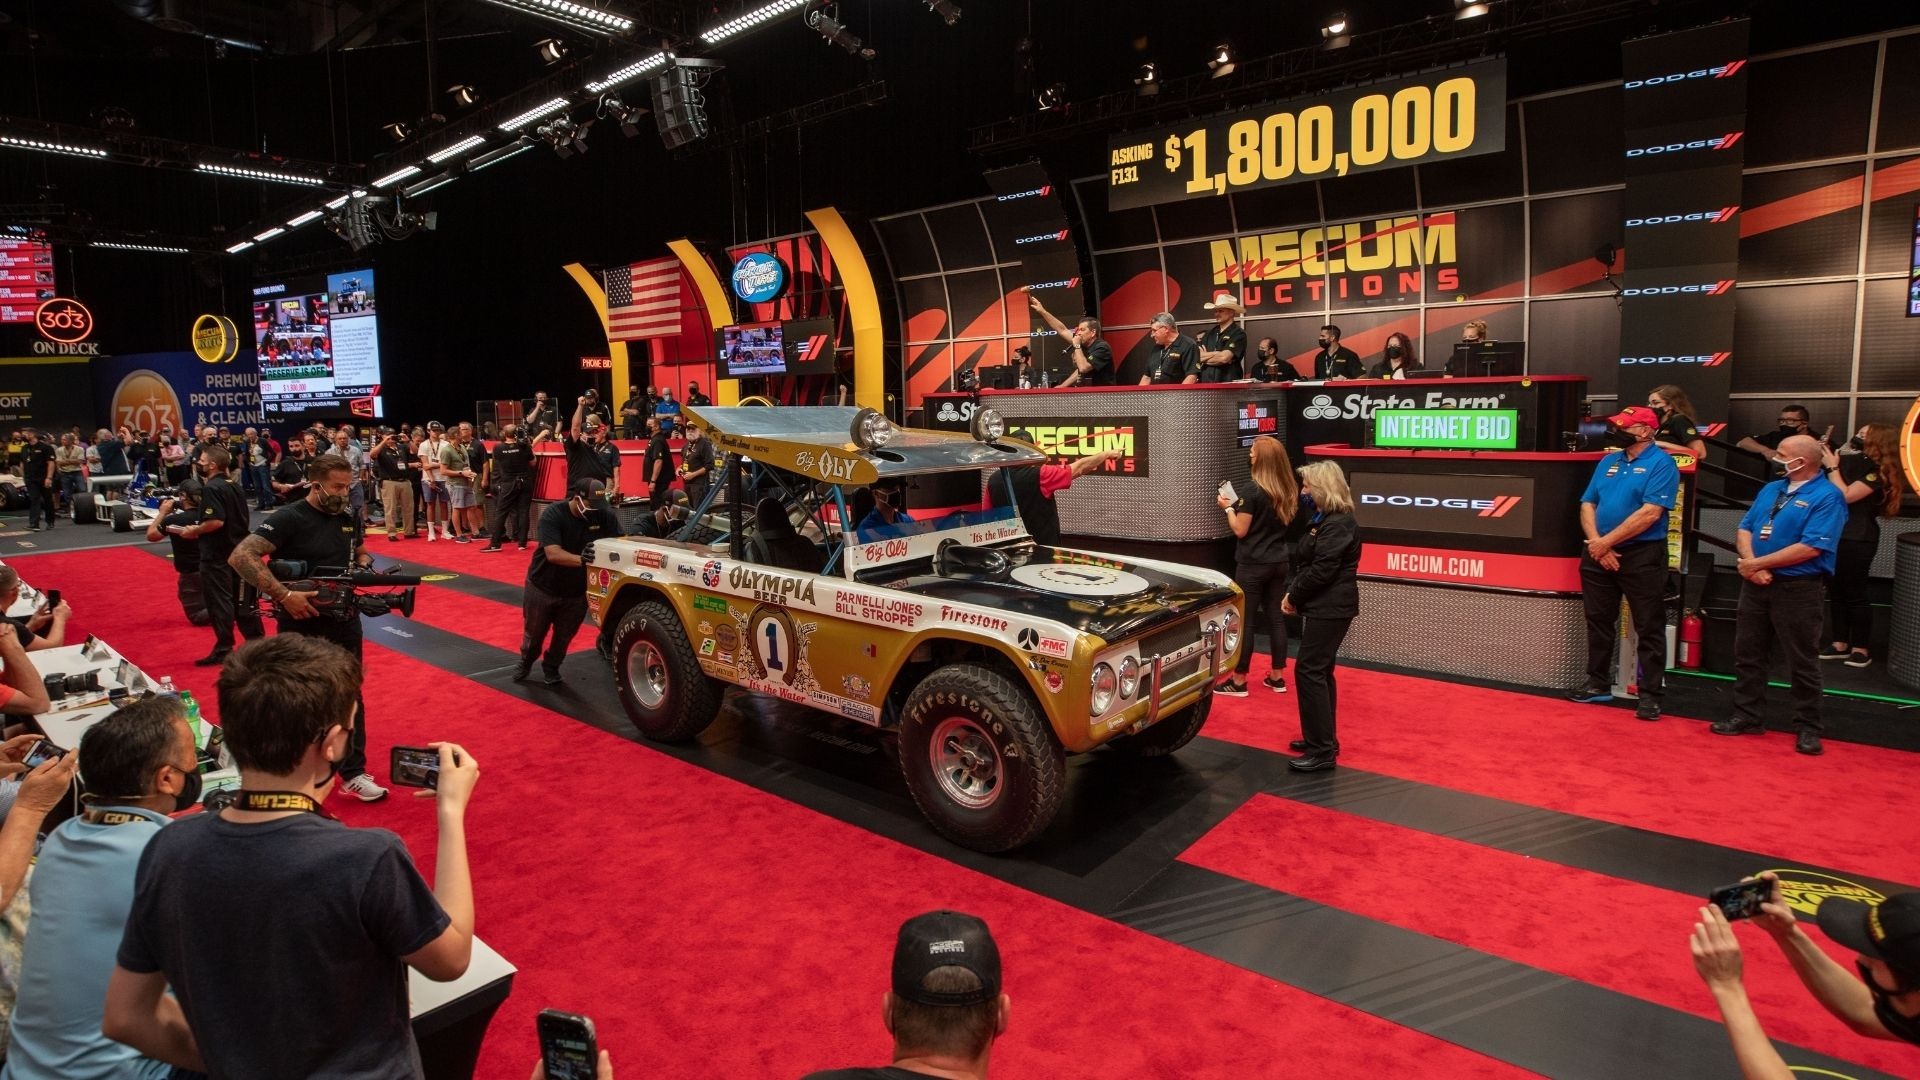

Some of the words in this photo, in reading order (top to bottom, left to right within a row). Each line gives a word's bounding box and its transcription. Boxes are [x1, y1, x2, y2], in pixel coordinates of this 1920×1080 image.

[1625, 66, 1728, 88] DODGE
[1112, 142, 1153, 166] ASKING
[1165, 77, 1475, 195] $1,800,000
[1627, 138, 1725, 157] DODGE
[1112, 165, 1138, 185] F131
[998, 188, 1043, 201] DODGE
[1626, 211, 1722, 227] DODGE
[1016, 232, 1061, 244] DODGE
[1210, 211, 1456, 285] MECUM
[1027, 280, 1071, 290] DODGE
[1624, 284, 1718, 296] DODGE
[42, 312, 85, 328] 303
[33, 341, 55, 354] ON
[58, 341, 99, 354] DECK
[582, 358, 602, 368] PHONE
[1620, 355, 1714, 365] DODGE
[267, 368, 299, 379] RESERVE
[301, 367, 309, 377] IS
[312, 366, 326, 376] OFF
[206, 374, 259, 389] PREMIU
[190, 393, 260, 407] PROTECTA
[119, 405, 174, 436] 303
[198, 412, 209, 424] &
[211, 410, 285, 424] CLEANE
[1380, 415, 1471, 440] INTERNET
[1476, 416, 1510, 440] BID
[796, 451, 815, 472] Big
[818, 448, 858, 481] OLY
[1361, 494, 1495, 510] DODGE
[985, 530, 997, 541] the
[865, 547, 883, 562] Big
[1387, 552, 1484, 578] MECUM.COM
[729, 565, 817, 606] OLYMPIA
[754, 590, 788, 606] BEER
[836, 590, 884, 610] PARNELLI
[887, 600, 923, 616] JONES
[836, 602, 856, 616] BILL
[862, 608, 914, 627] STROPPE
[941, 605, 1008, 632] Firestone
[766, 623, 783, 671] 1
[1041, 640, 1065, 652] FMC
[1165, 646, 1193, 664] ORD
[764, 683, 777, 695] the
[779, 687, 806, 704] Water
[813, 691, 838, 704] SIMPSON
[842, 699, 873, 713] CRAGAR
[911, 692, 1003, 735] Firestone
[248, 793, 314, 812] MECUM
